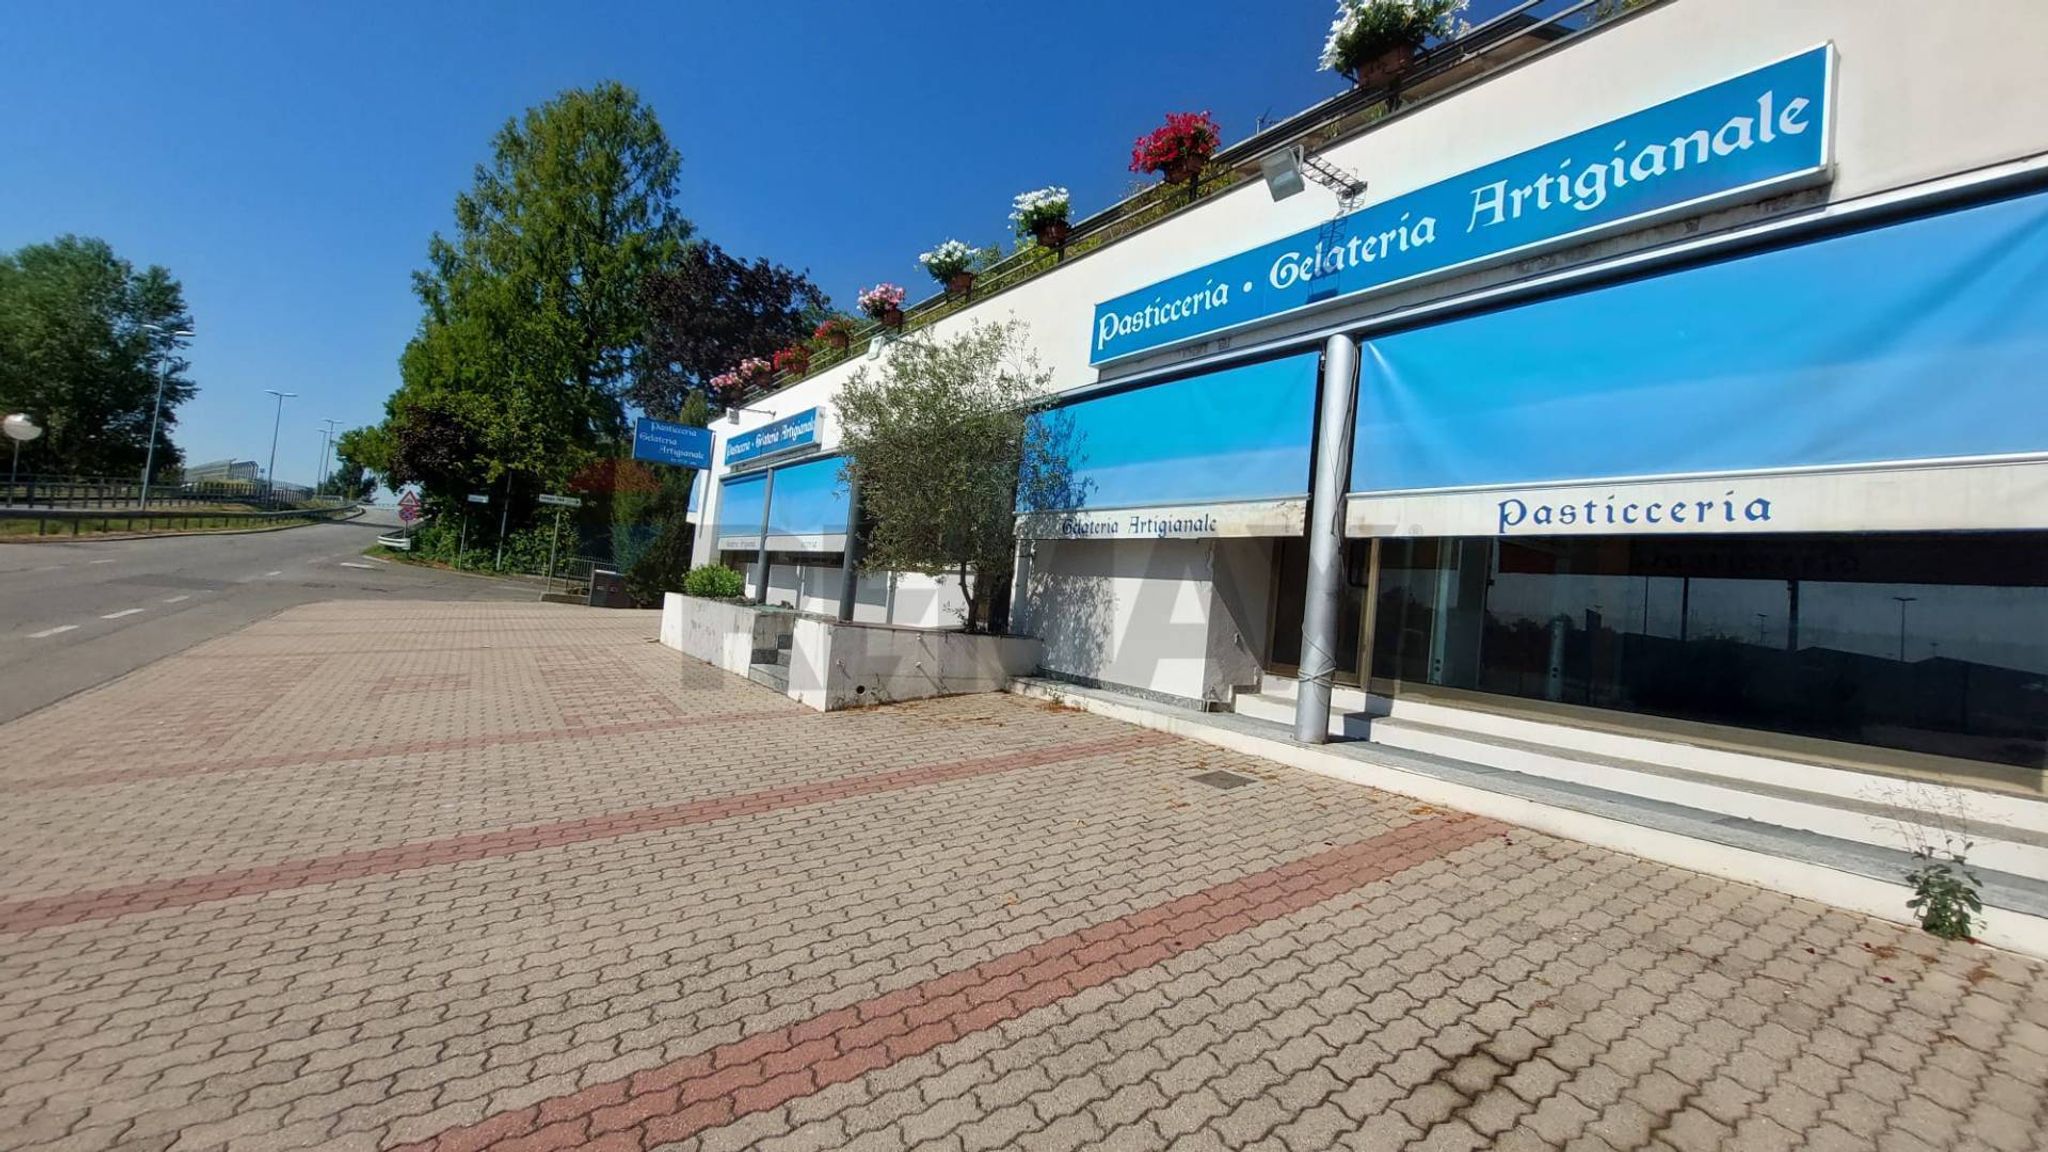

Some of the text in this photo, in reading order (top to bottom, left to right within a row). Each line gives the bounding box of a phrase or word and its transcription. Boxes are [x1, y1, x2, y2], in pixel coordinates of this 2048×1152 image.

[1097, 90, 1810, 350] Pasticceria Gelateria Artigianale
[1062, 513, 1217, 538] Gelateria Artigianale
[1497, 490, 1773, 534] Pasticceria
